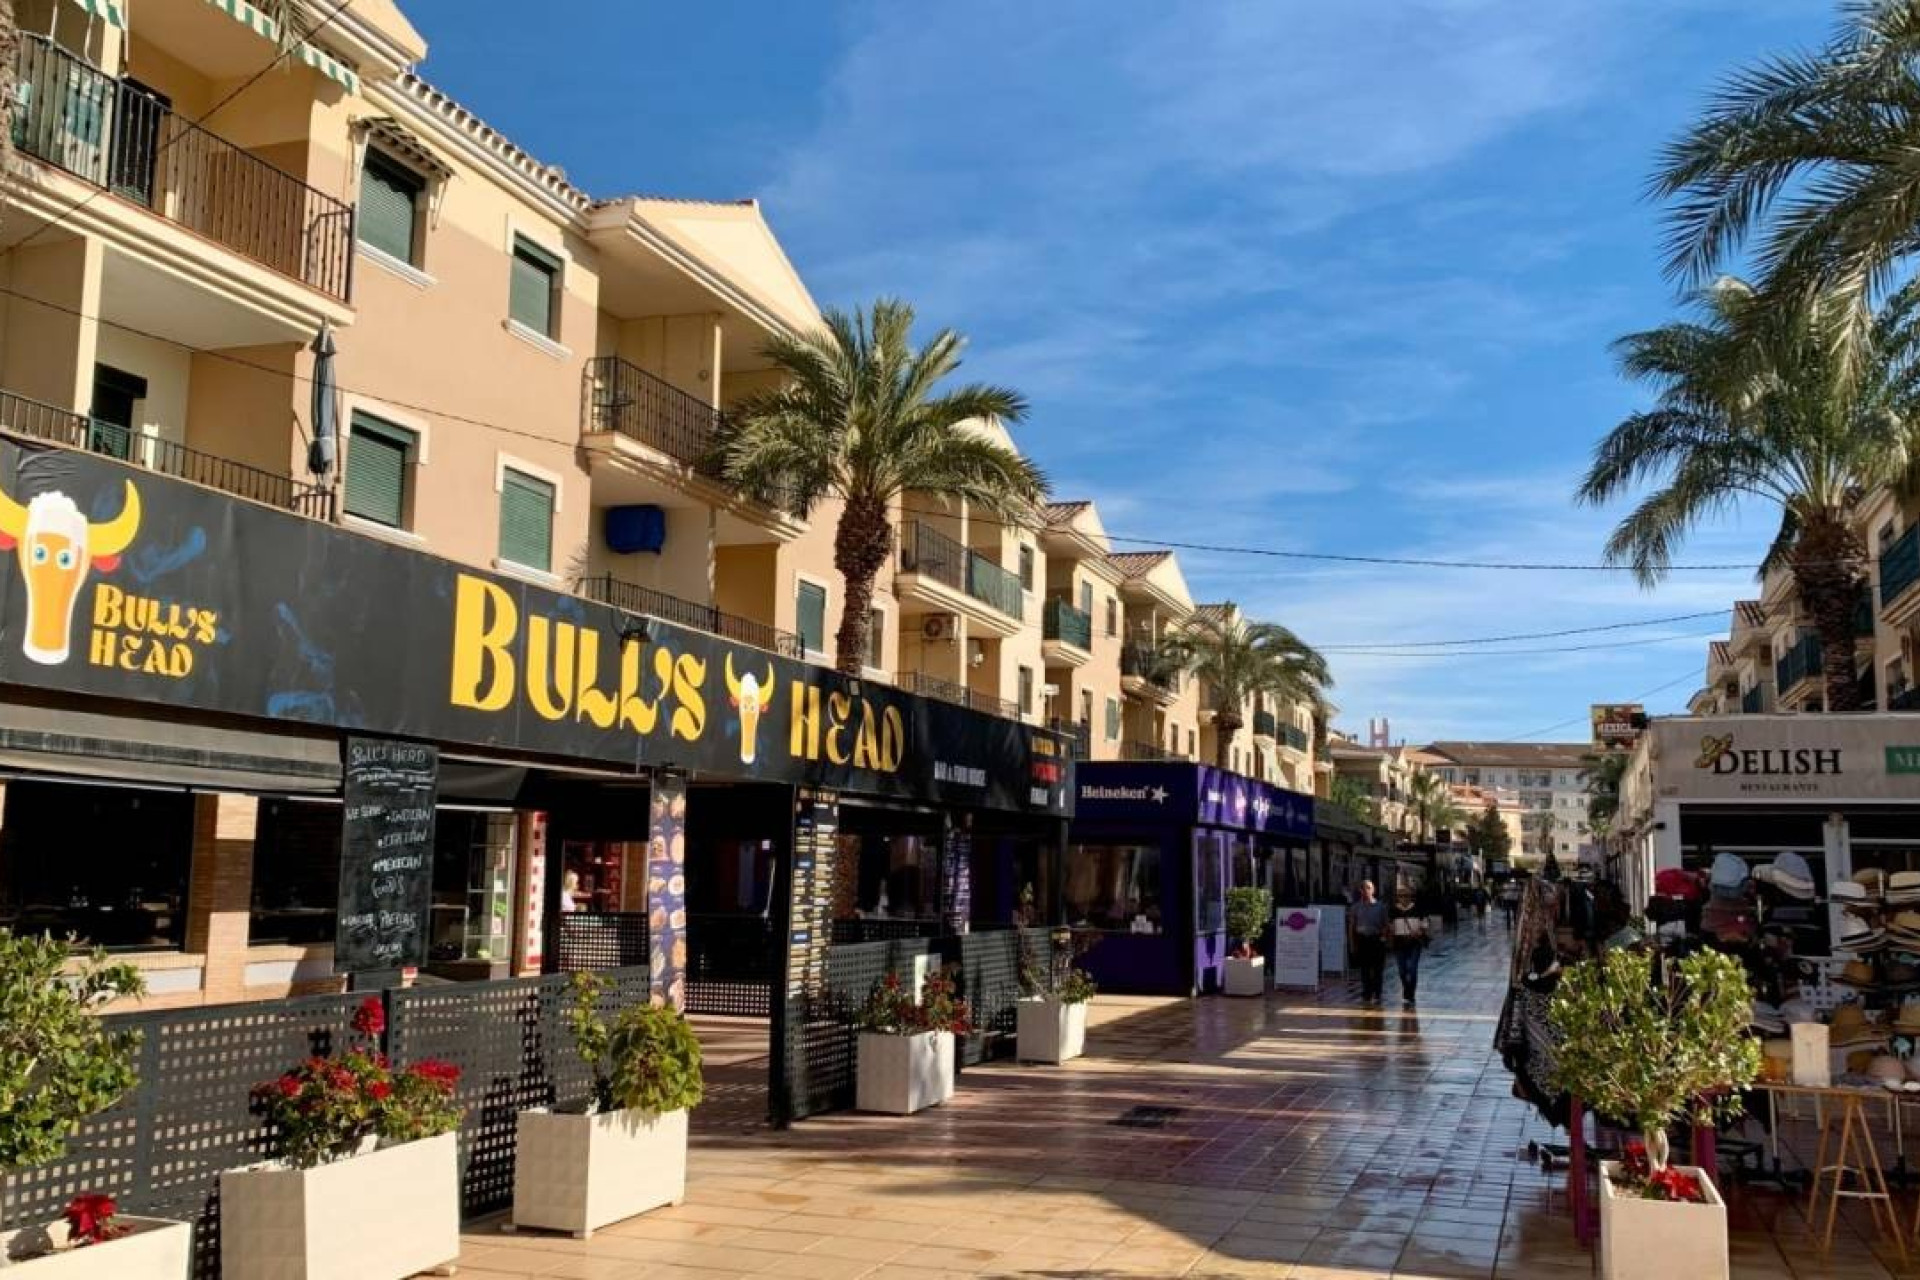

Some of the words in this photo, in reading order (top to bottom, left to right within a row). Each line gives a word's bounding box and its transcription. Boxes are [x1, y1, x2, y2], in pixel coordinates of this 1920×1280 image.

[93, 582, 218, 644] BULL'S
[90, 628, 194, 678] HEAD
[451, 573, 707, 742] BULL'S
[790, 680, 904, 773] HEAD
[1712, 748, 1844, 775] DELISH
[1081, 784, 1146, 799] Heineken
